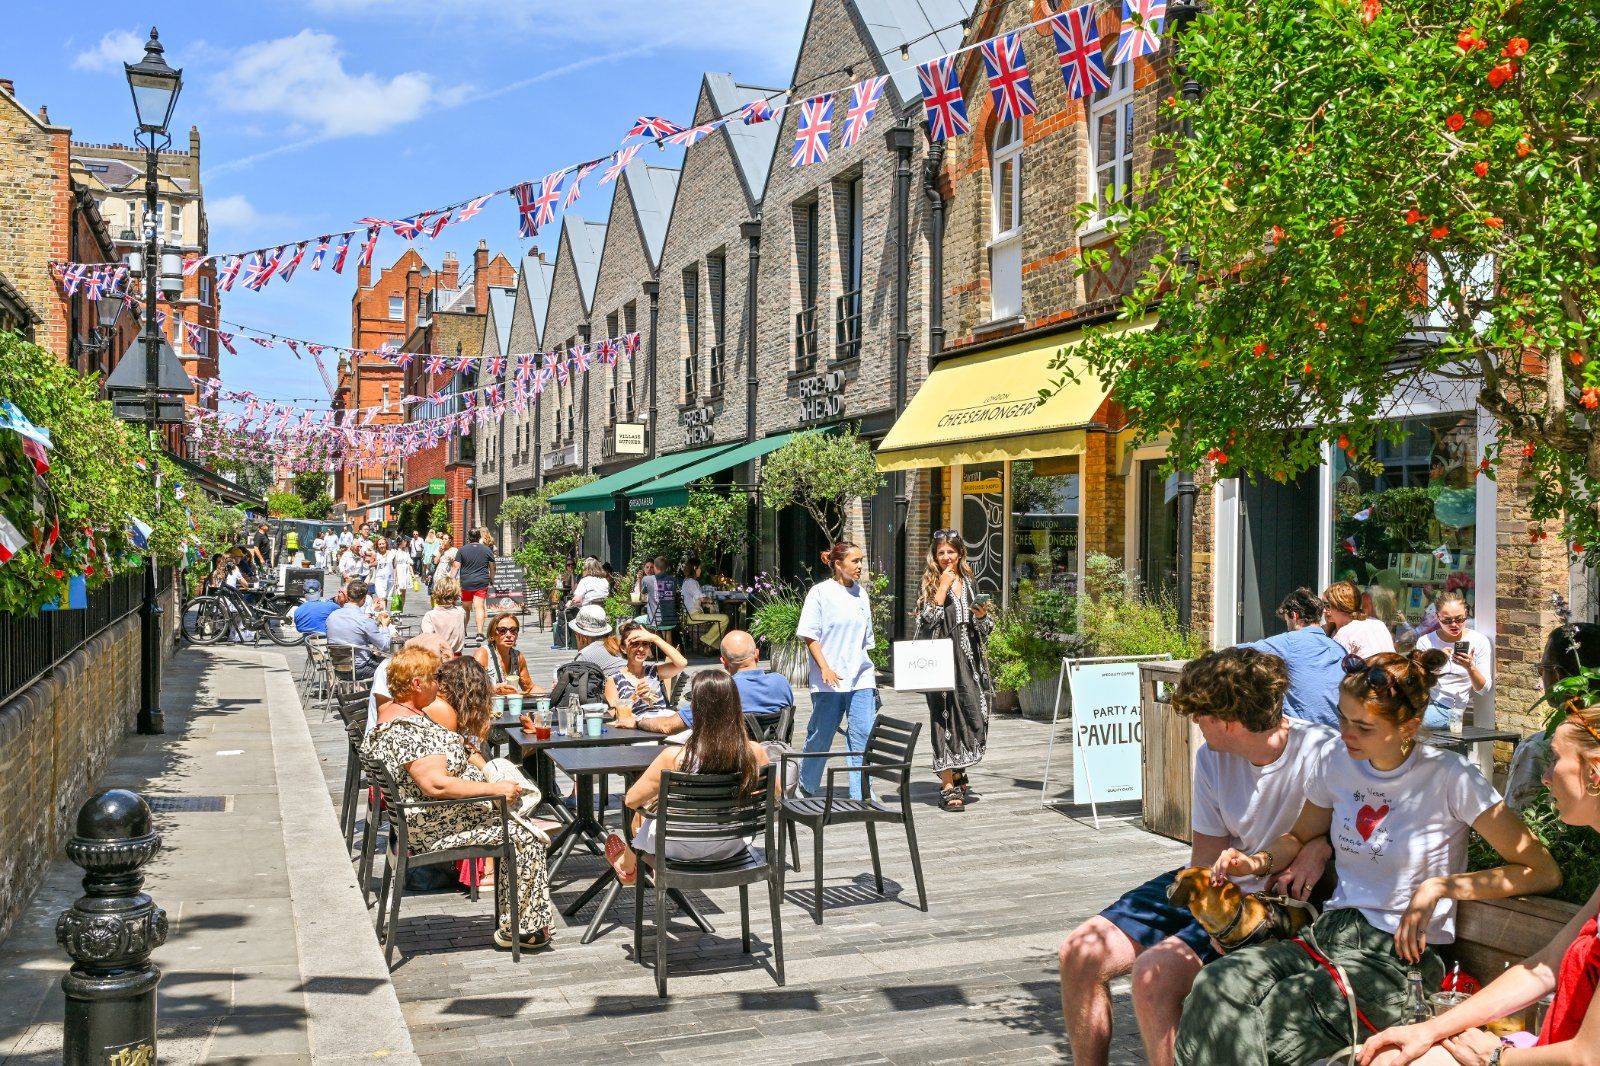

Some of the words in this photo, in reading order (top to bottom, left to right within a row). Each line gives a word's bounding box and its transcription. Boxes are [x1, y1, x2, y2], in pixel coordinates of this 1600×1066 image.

[799, 370, 846, 398] BREAD
[799, 395, 846, 421] AHEAD
[983, 393, 1010, 403] LONDON
[683, 405, 714, 427] BREAD
[937, 401, 1040, 428] CHEESEMONGERS
[683, 425, 714, 445] AHEAD
[1032, 520, 1059, 528] LONDON
[1093, 705, 1127, 719] PARTY
